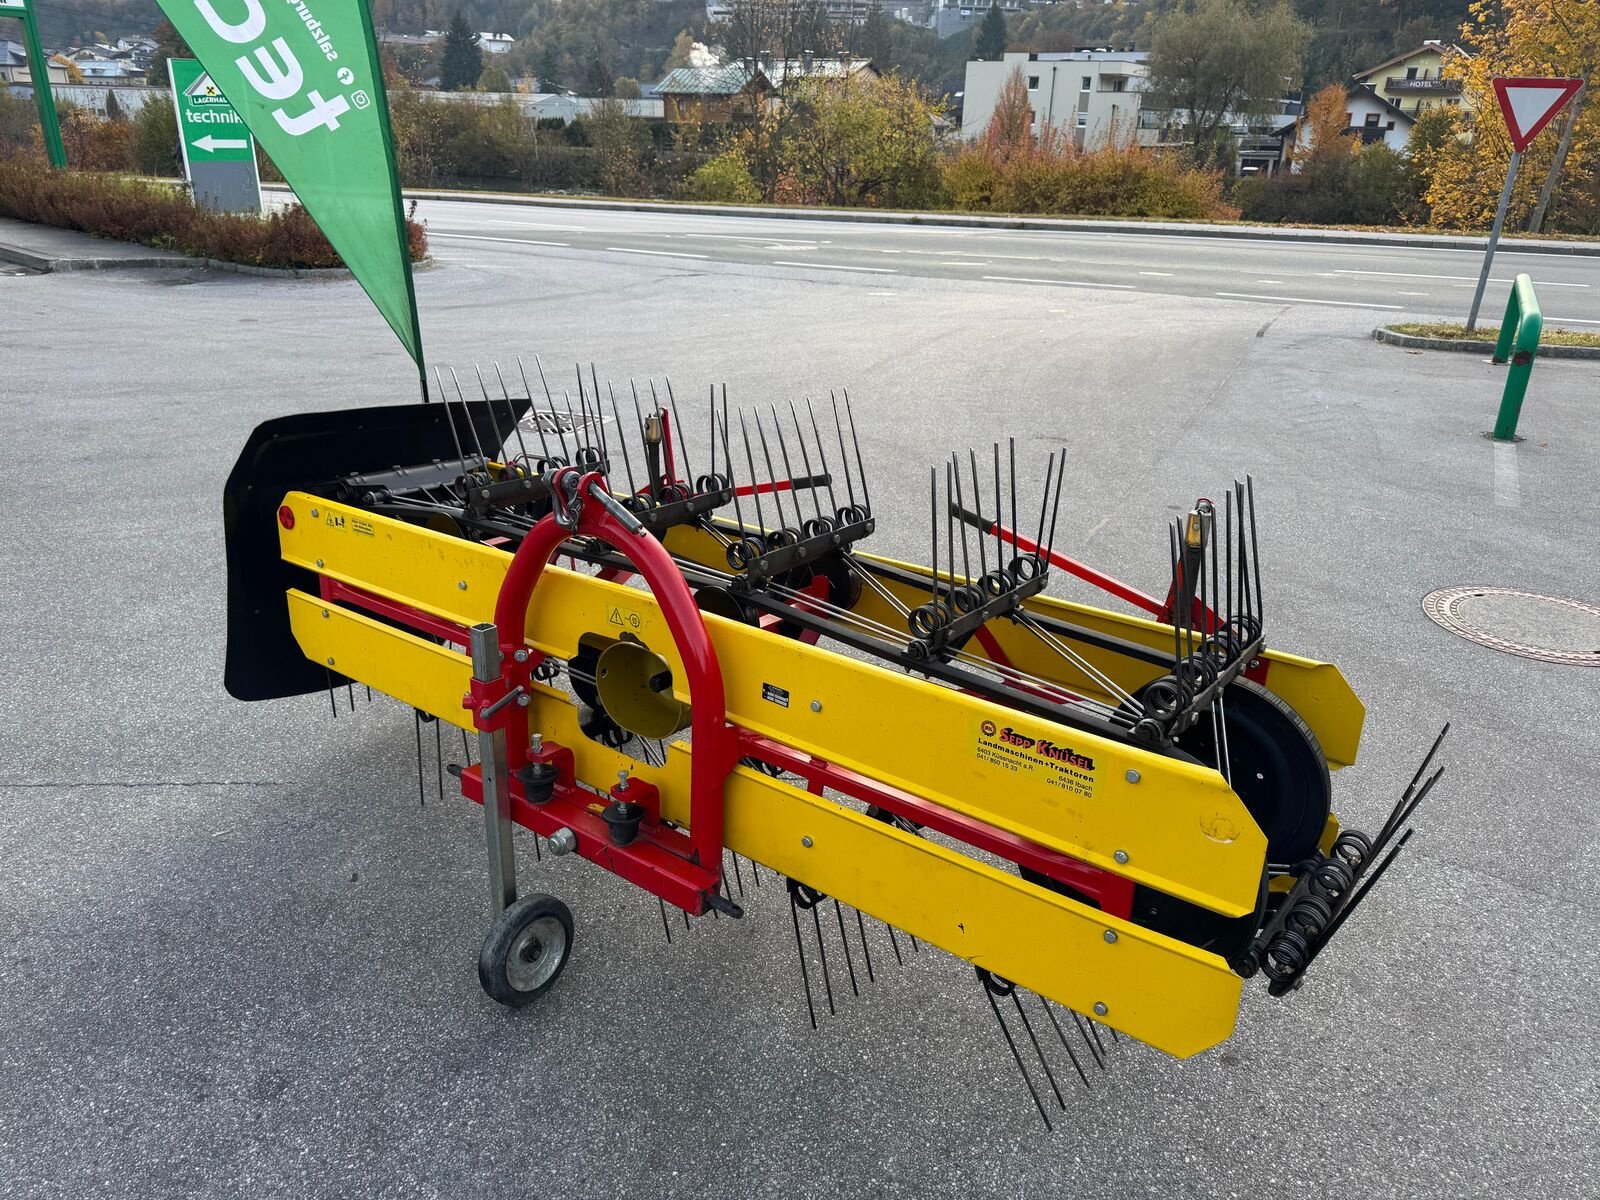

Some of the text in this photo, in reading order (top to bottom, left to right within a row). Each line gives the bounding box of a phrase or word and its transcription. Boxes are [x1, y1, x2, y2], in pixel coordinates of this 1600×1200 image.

[1409, 80, 1433, 88] HOTEL
[185, 108, 243, 123] technik
[977, 747, 991, 756] 6403
[978, 737, 1094, 783] Landmaschinen+Traktoren
[1010, 763, 1018, 772] 33
[1058, 775, 1093, 792] 6438 Ibach
[1074, 787, 1083, 795] 07
